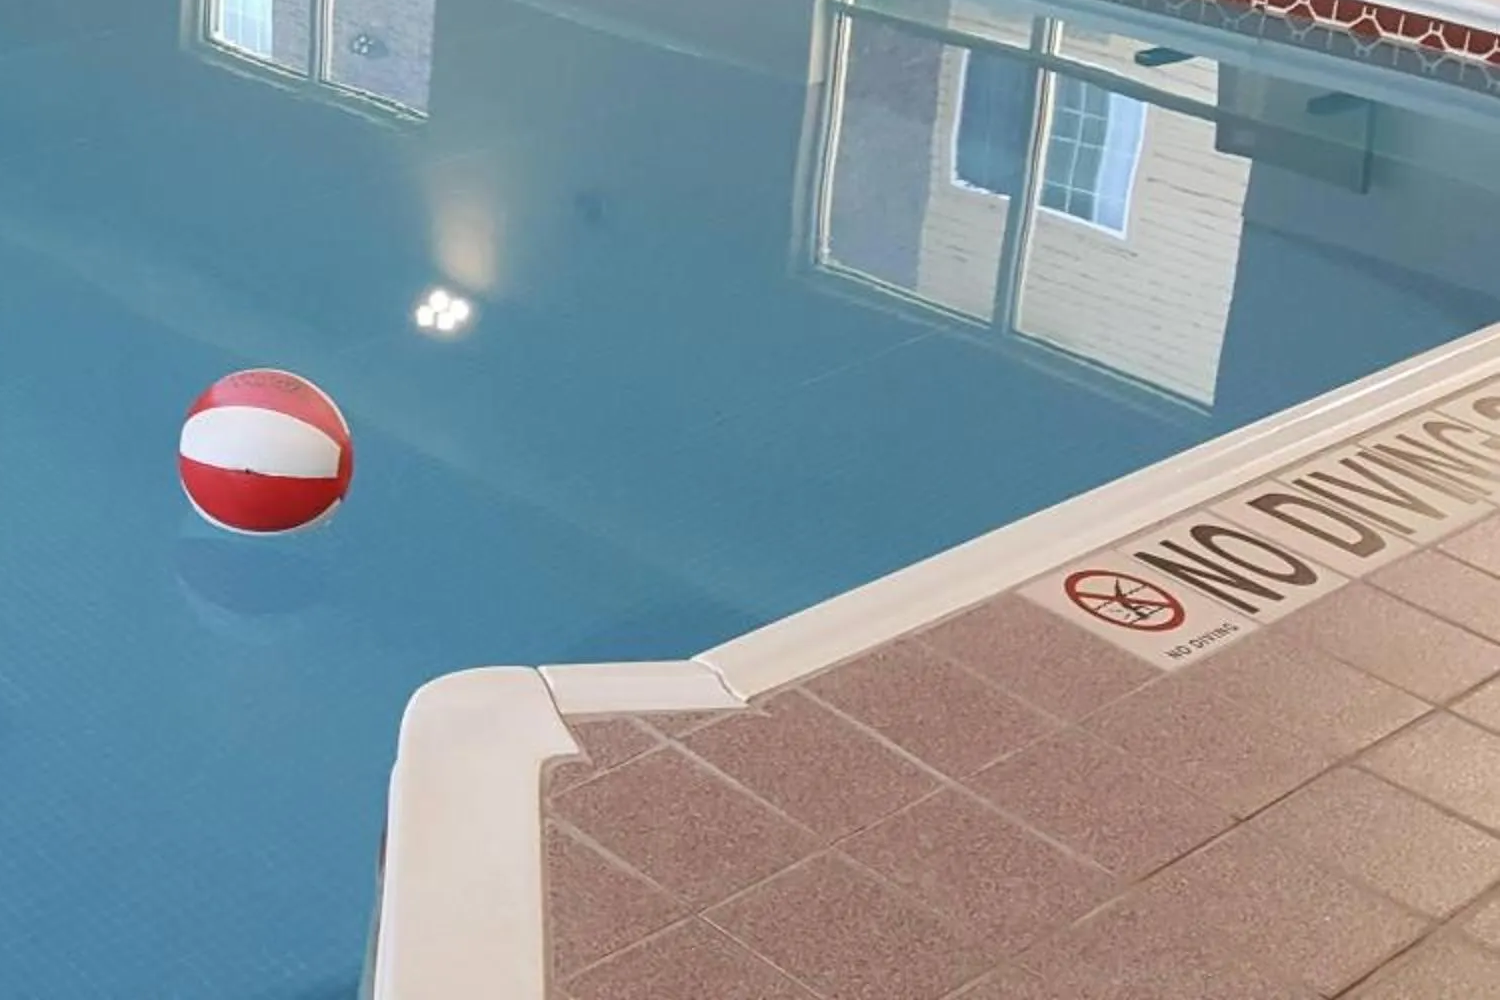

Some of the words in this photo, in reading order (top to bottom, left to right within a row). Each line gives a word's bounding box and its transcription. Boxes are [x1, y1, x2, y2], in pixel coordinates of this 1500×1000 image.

[1133, 525, 1317, 614] NO
[1164, 645, 1192, 658] NO
[1188, 623, 1239, 648] DIVING
